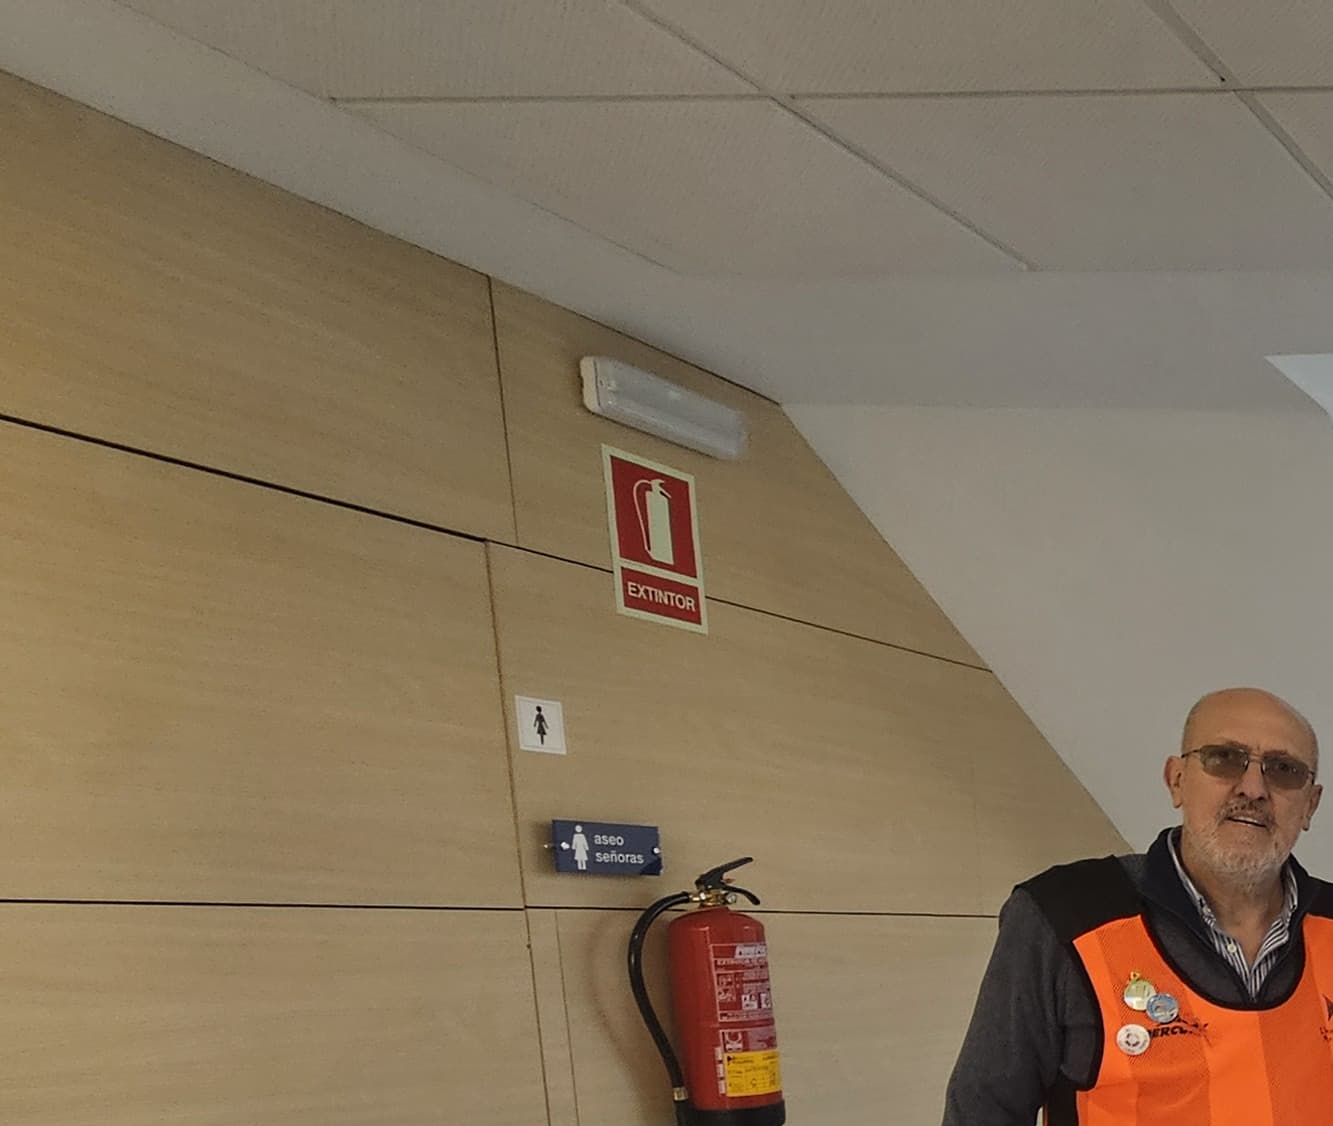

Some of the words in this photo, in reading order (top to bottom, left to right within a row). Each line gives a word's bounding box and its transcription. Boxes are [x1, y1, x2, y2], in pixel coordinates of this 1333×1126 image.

[627, 582, 696, 612] EXTINTOR
[593, 834, 625, 846] aseo
[595, 851, 645, 864] señoras
